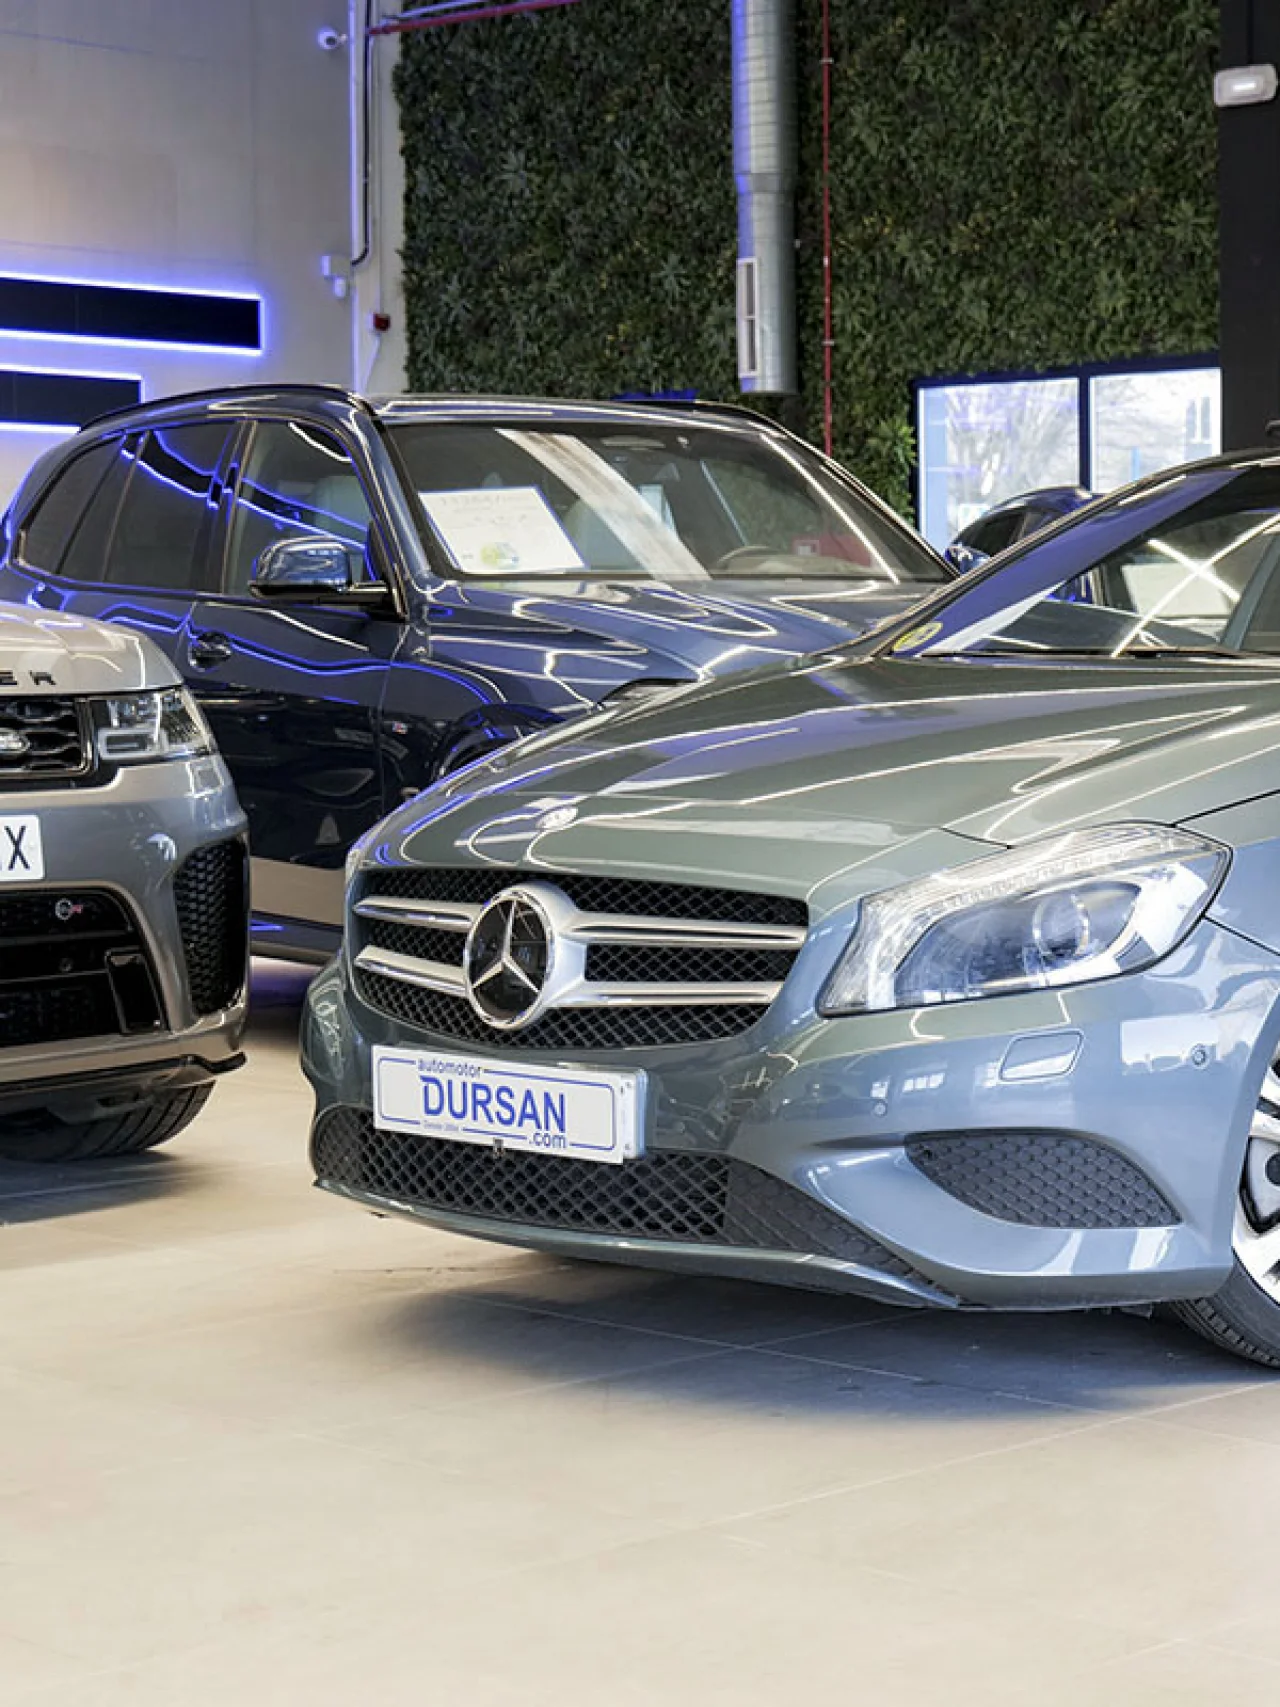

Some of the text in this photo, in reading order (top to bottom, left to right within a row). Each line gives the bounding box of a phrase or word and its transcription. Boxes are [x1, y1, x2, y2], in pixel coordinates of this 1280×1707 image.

[418, 1058, 481, 1078] automotor
[420, 1075, 566, 1132] DURSAN
[529, 1132, 567, 1149] .com
